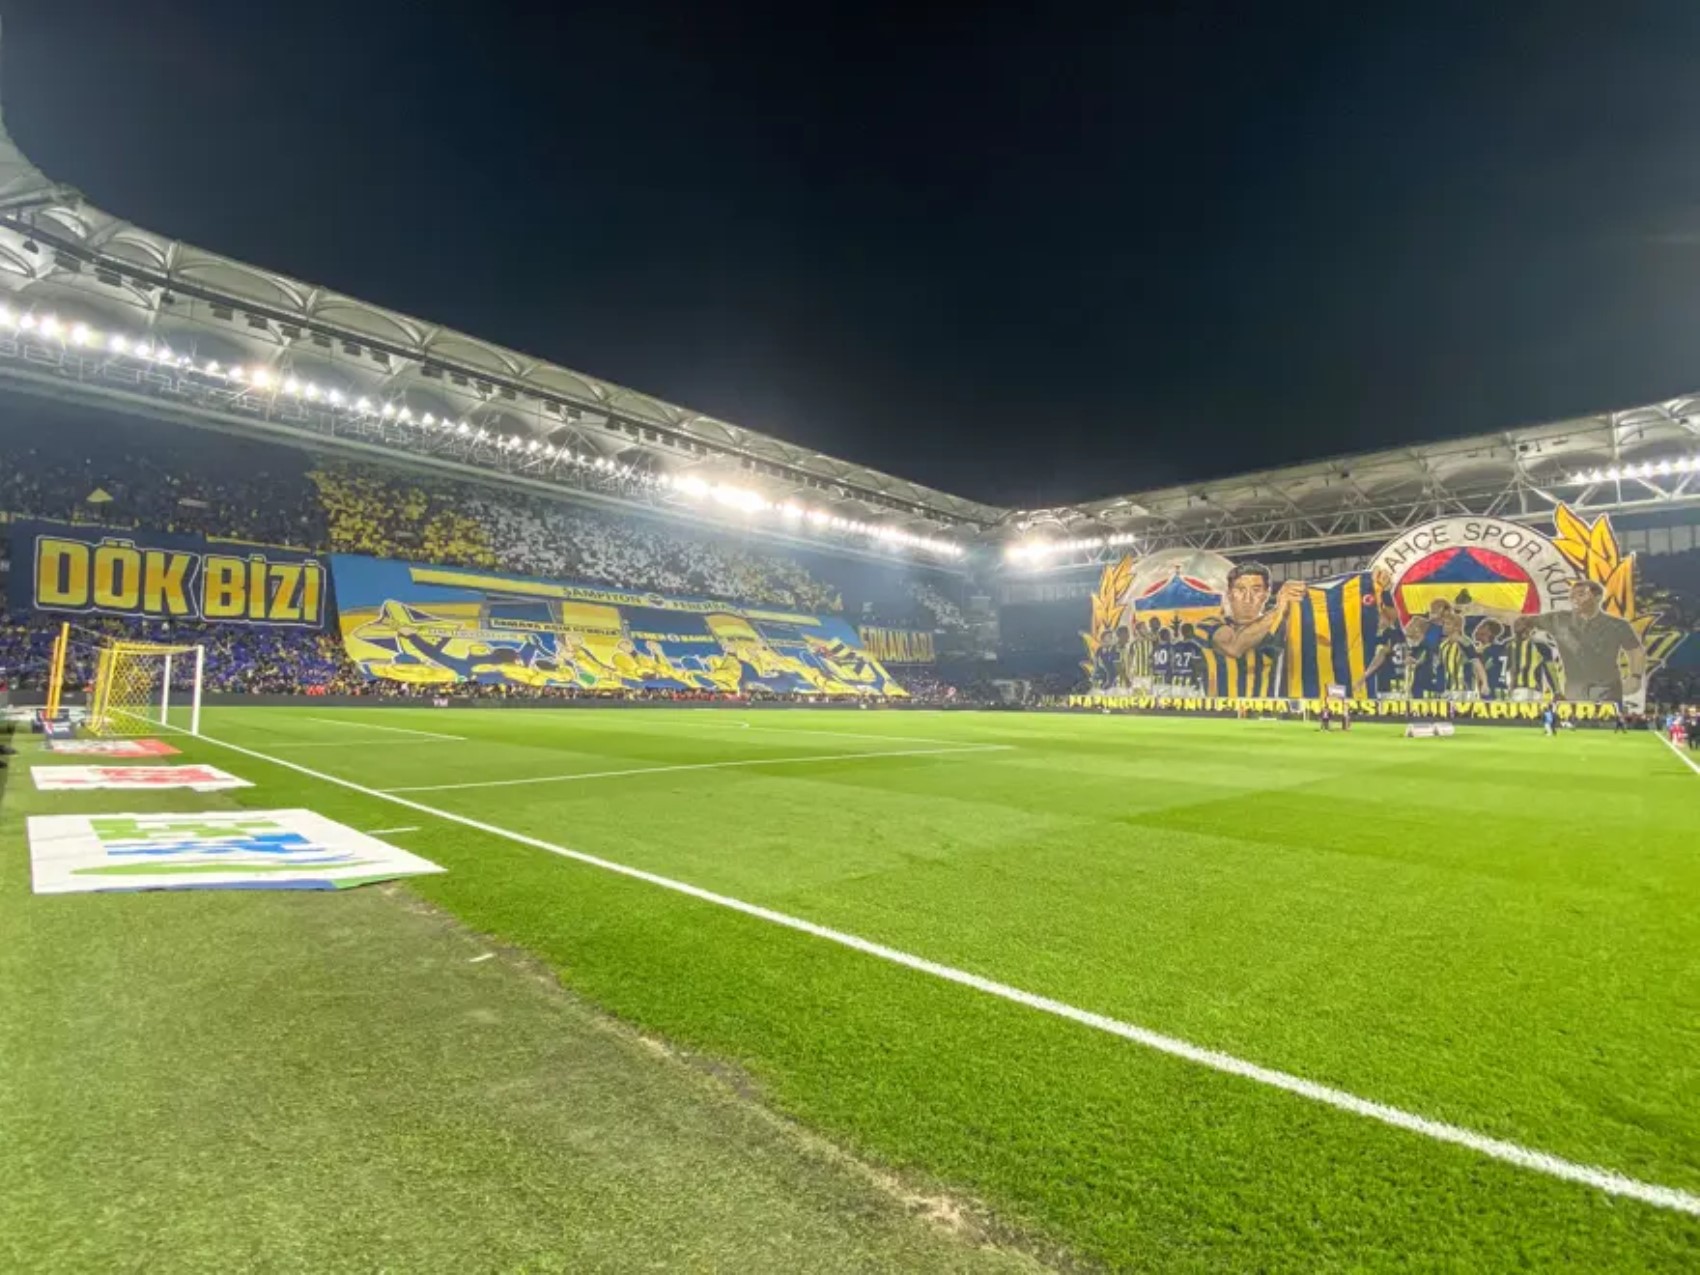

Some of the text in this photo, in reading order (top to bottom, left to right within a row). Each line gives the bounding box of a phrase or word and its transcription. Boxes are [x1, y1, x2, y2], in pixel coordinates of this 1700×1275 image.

[1463, 522, 1543, 561] SPOR
[36, 537, 320, 622] DÖK BİZİ
[1175, 652, 1192, 667] 27
